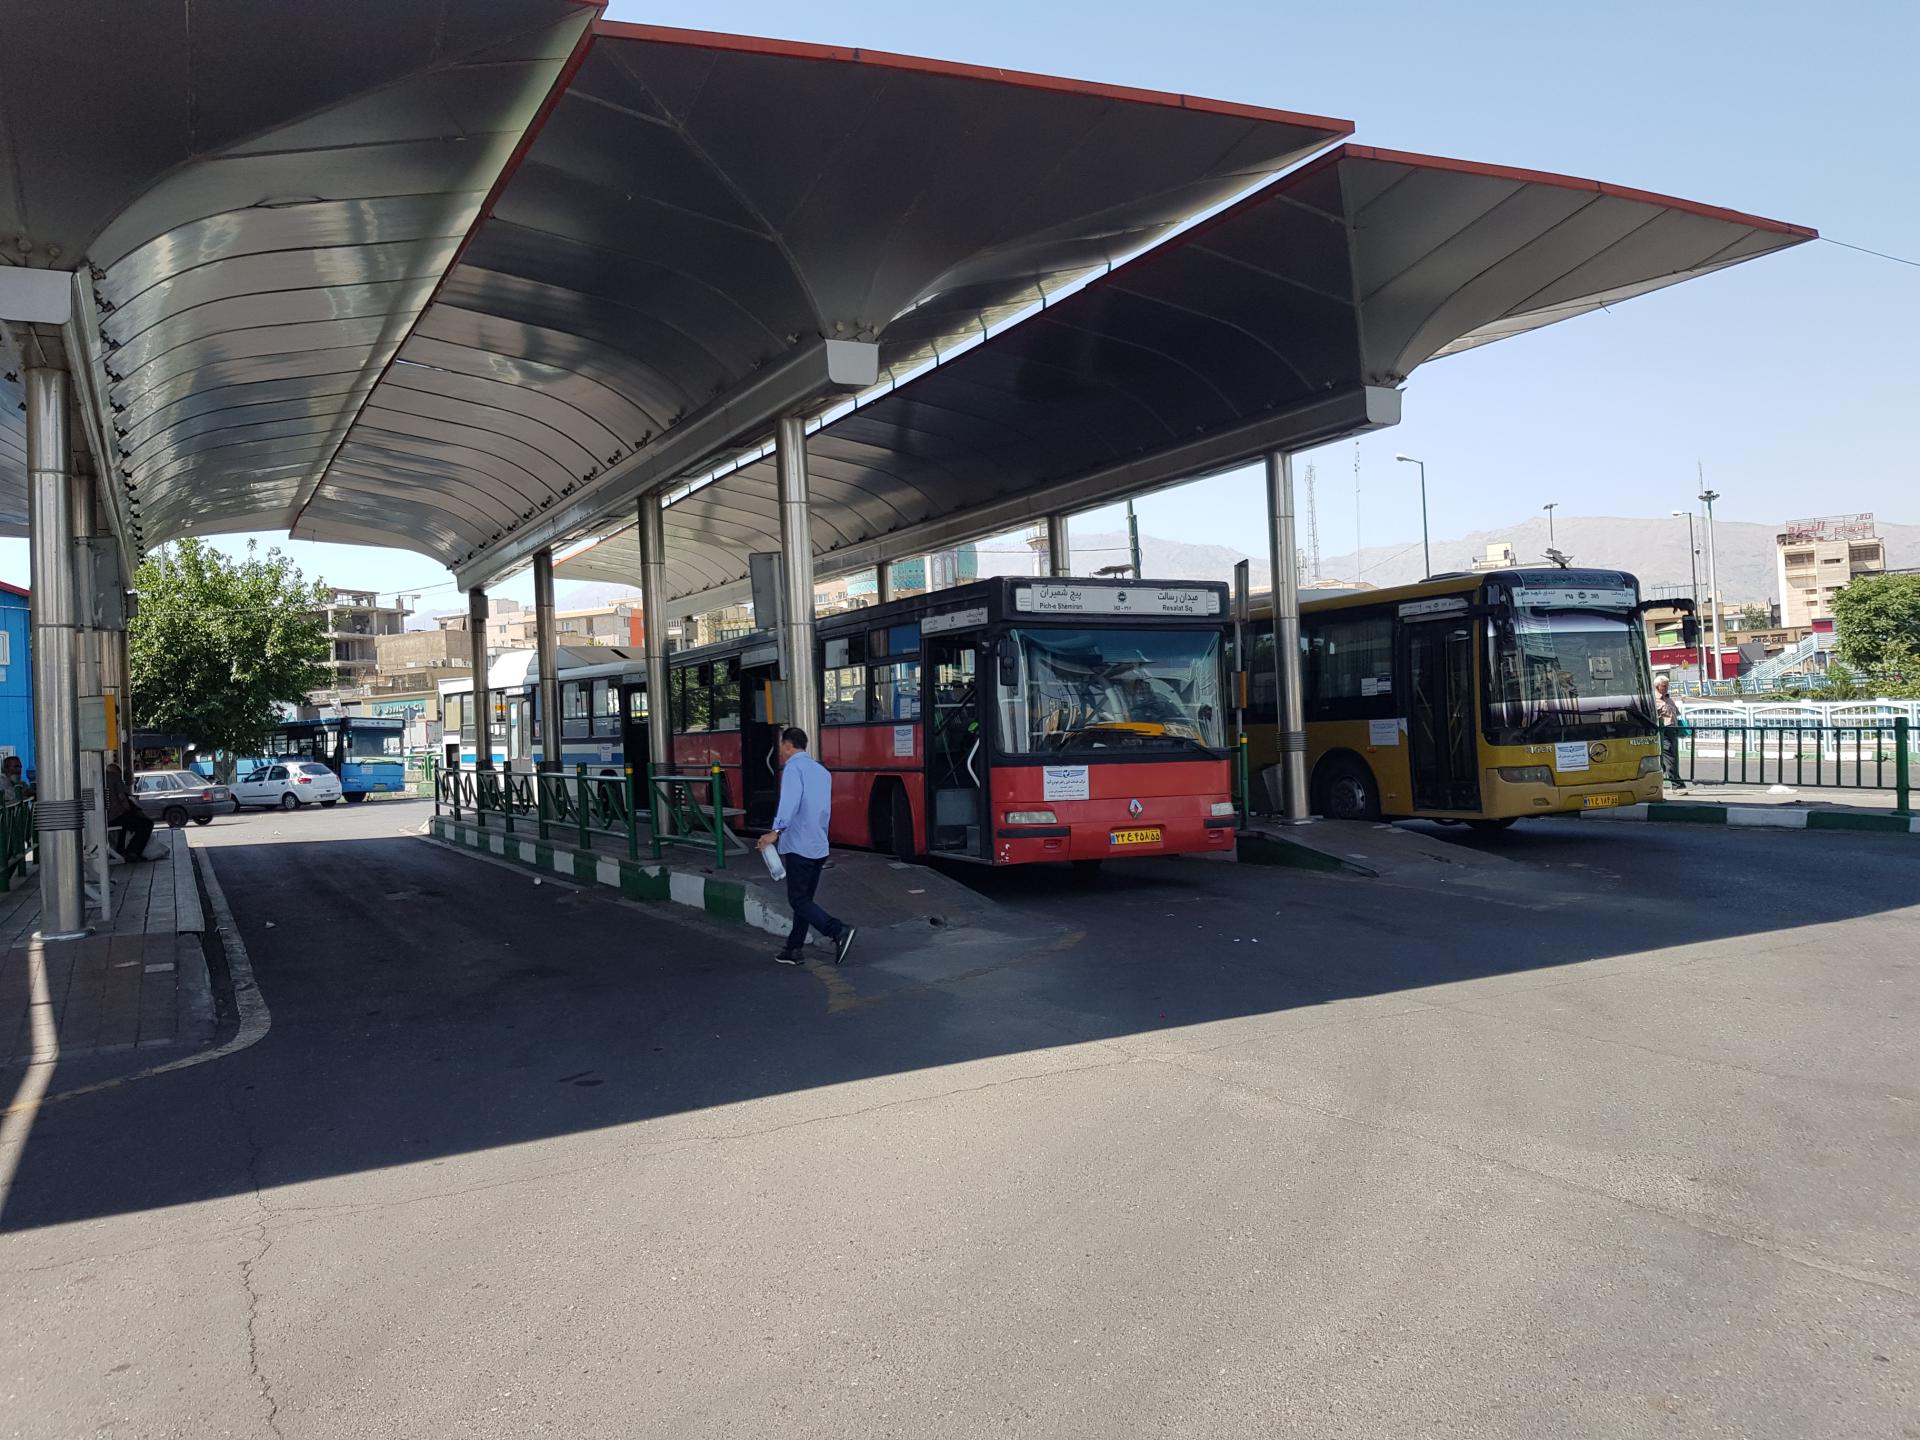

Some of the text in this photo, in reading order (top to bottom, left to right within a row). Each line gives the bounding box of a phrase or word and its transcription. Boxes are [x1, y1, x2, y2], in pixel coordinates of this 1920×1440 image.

[1039, 588, 1082, 601] پیچ شمیران
[1157, 591, 1199, 604] میدان رسالت
[1057, 602, 1083, 610] Shemiran
